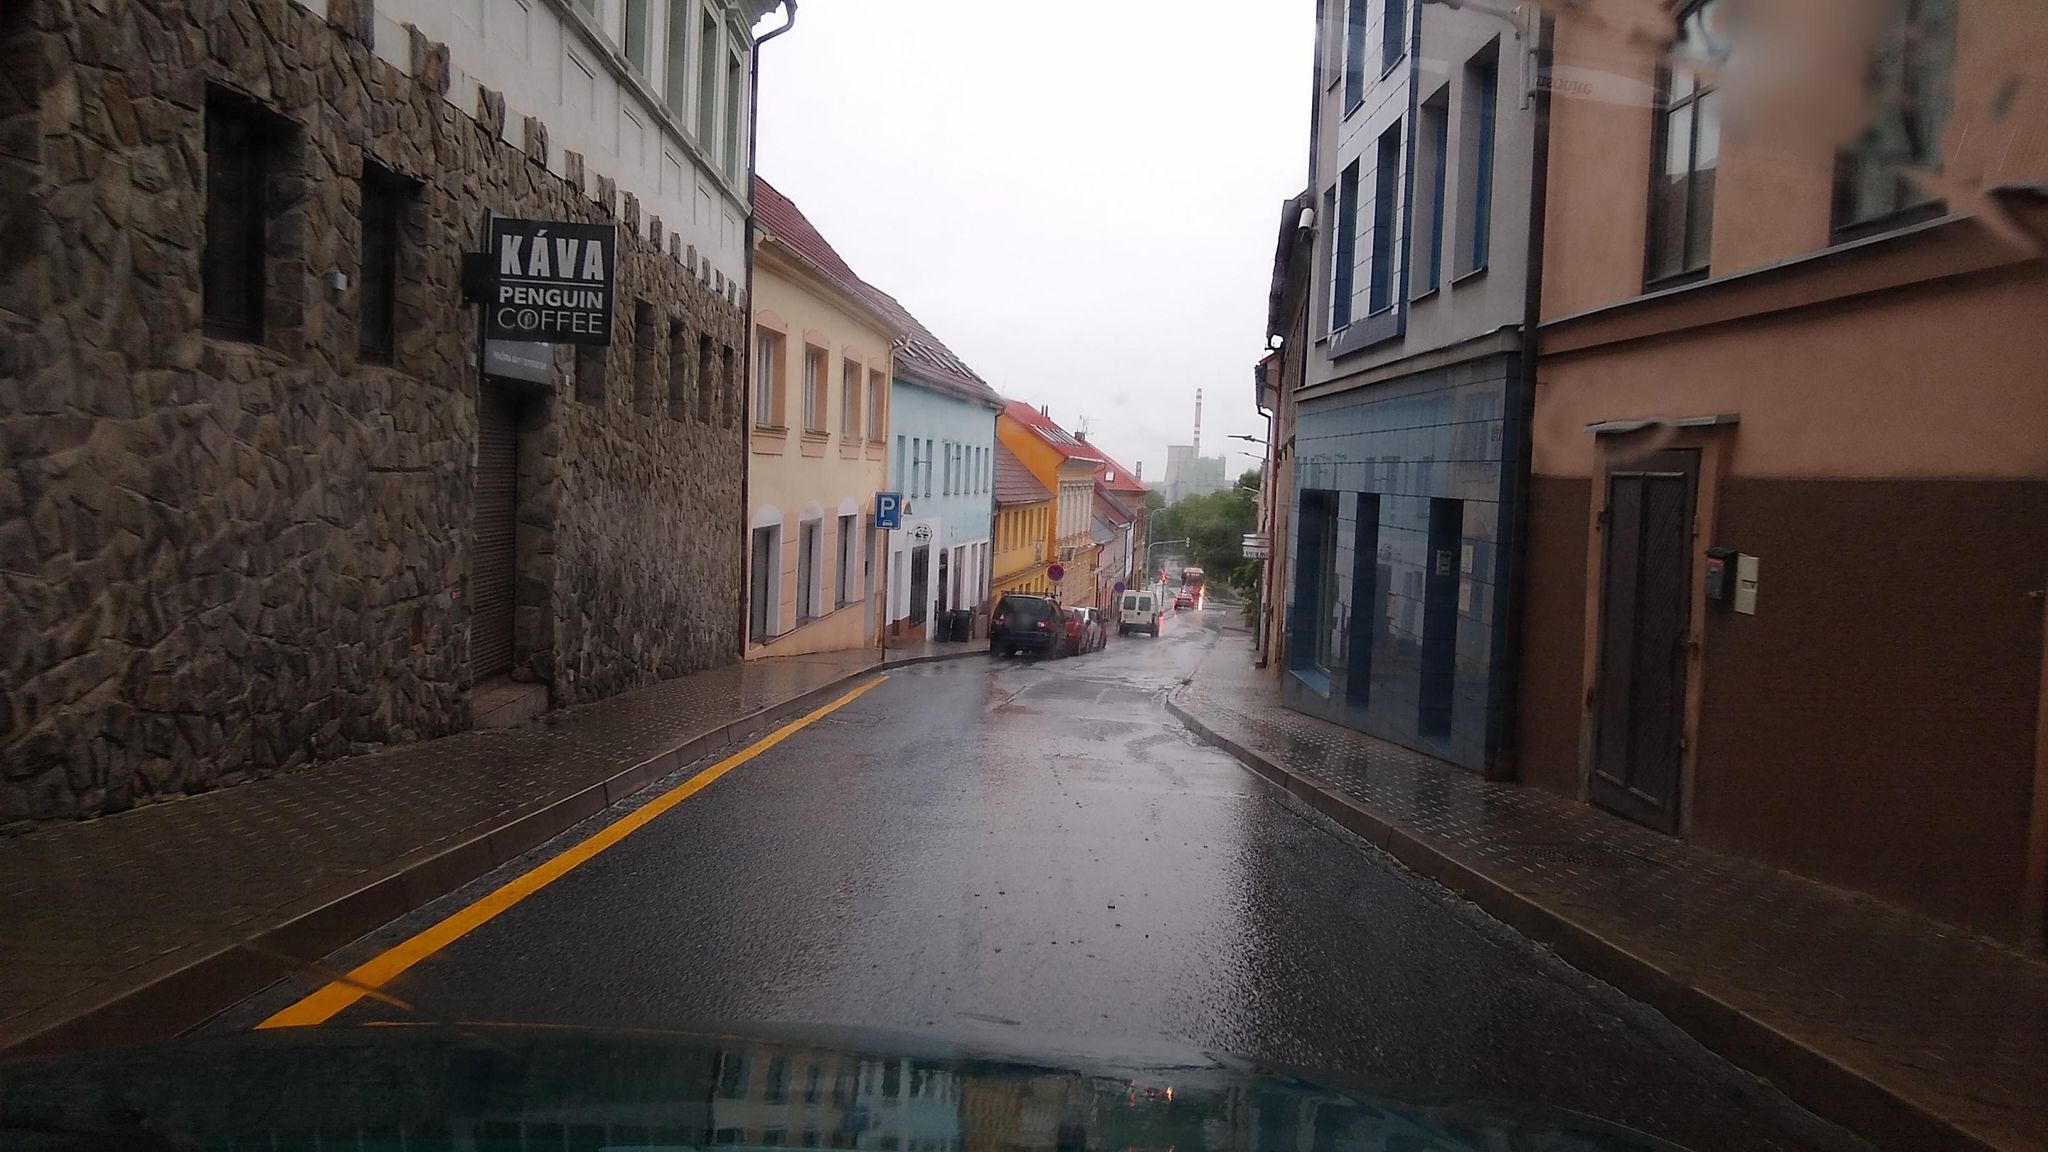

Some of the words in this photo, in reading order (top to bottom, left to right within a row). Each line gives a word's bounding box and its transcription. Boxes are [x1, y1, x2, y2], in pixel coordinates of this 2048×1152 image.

[501, 230, 604, 281] KÁVA
[500, 286, 603, 309] PENGUIN
[497, 307, 603, 334] COFFEE
[880, 497, 896, 518] P
